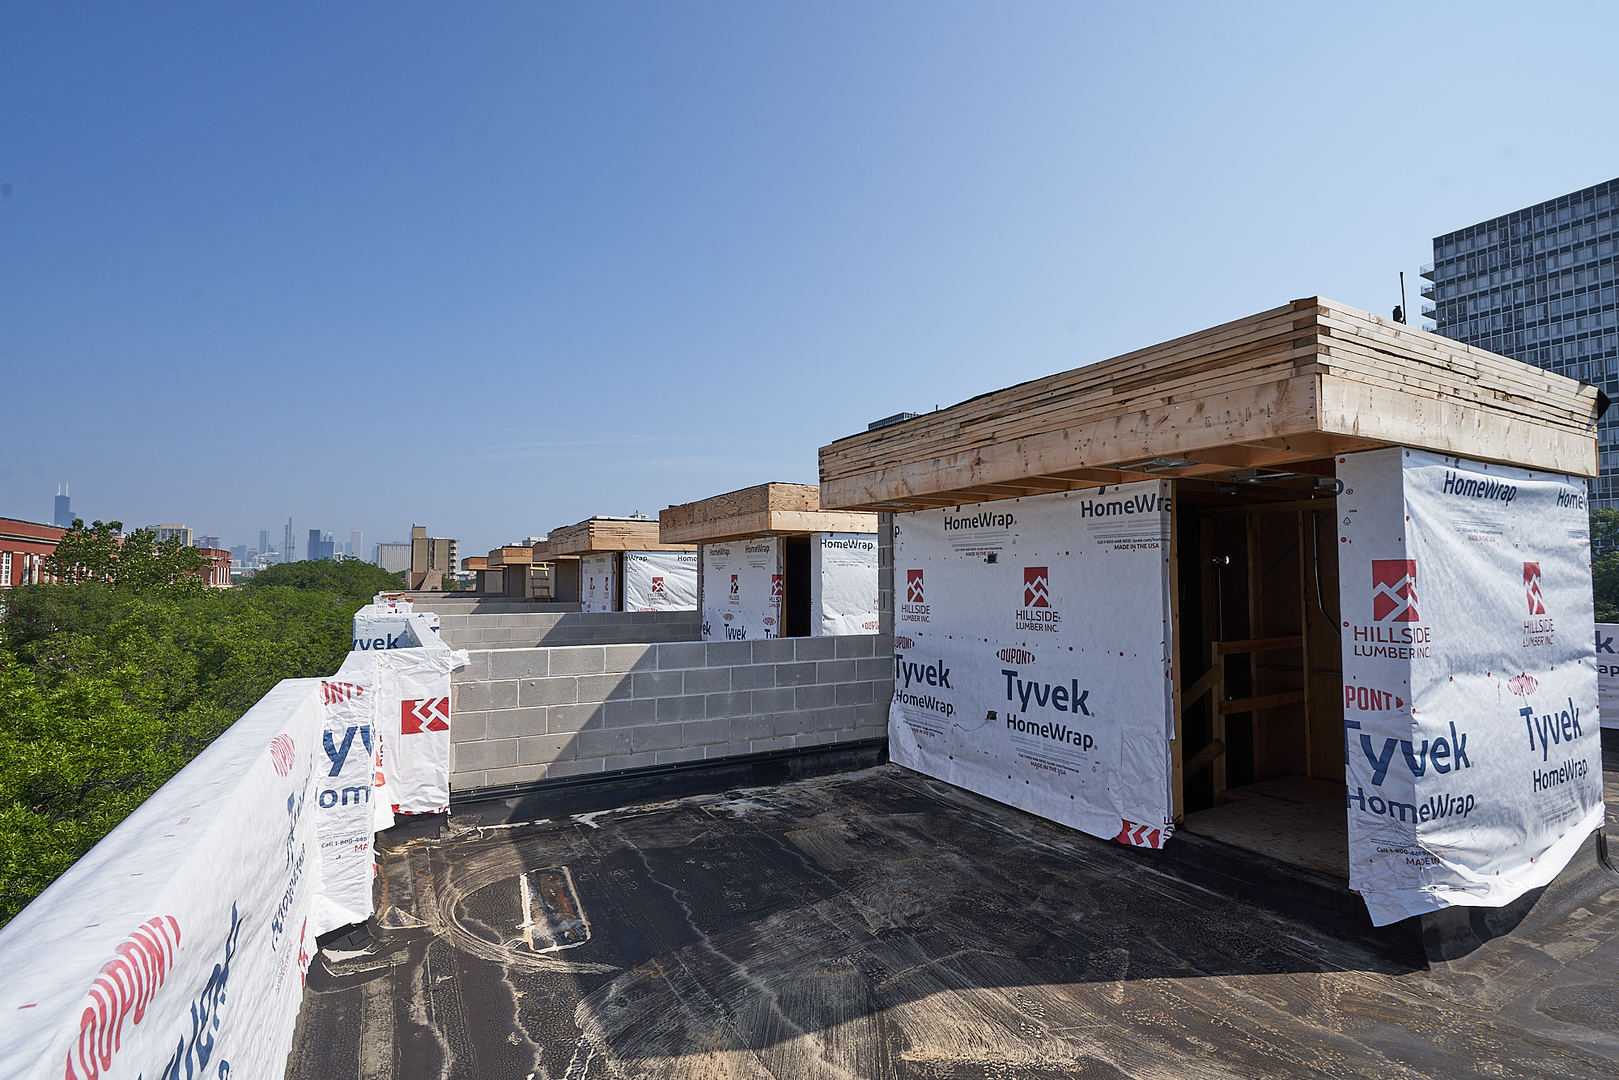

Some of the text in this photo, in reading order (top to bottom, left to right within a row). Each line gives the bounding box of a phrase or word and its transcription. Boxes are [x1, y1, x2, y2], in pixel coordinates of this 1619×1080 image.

[1443, 470, 1517, 507] HomeWrap
[944, 511, 1014, 530] HomeWrap
[744, 544, 770, 554] HomeWrap
[820, 539, 873, 551] HomeWrap
[901, 604, 930, 614] HILLSIDE
[1015, 609, 1059, 622] HILLSIDE
[901, 614, 921, 622] LUMBER
[1523, 618, 1555, 634] HILLSIDE
[724, 623, 747, 640] Tyvek
[1015, 622, 1044, 632] LUMBER
[1353, 625, 1431, 644] HILLSIDE
[1522, 636, 1544, 647] LUMBER
[1000, 648, 1032, 664] DUPONT
[1353, 644, 1414, 660] LUMBER
[895, 654, 951, 689] Tyvek
[1001, 669, 1090, 716] Tyvek
[1345, 685, 1393, 711] PONT
[896, 688, 954, 717] HomeWrap
[1006, 712, 1094, 752] HomeWrap
[1519, 697, 1582, 762] Tyvek
[1343, 720, 1471, 786] Tyvek
[1030, 761, 1043, 769] MADE
[1533, 758, 1587, 793] HomeWrap
[1346, 785, 1475, 824] HomeWrap
[1406, 857, 1431, 866] MADE
